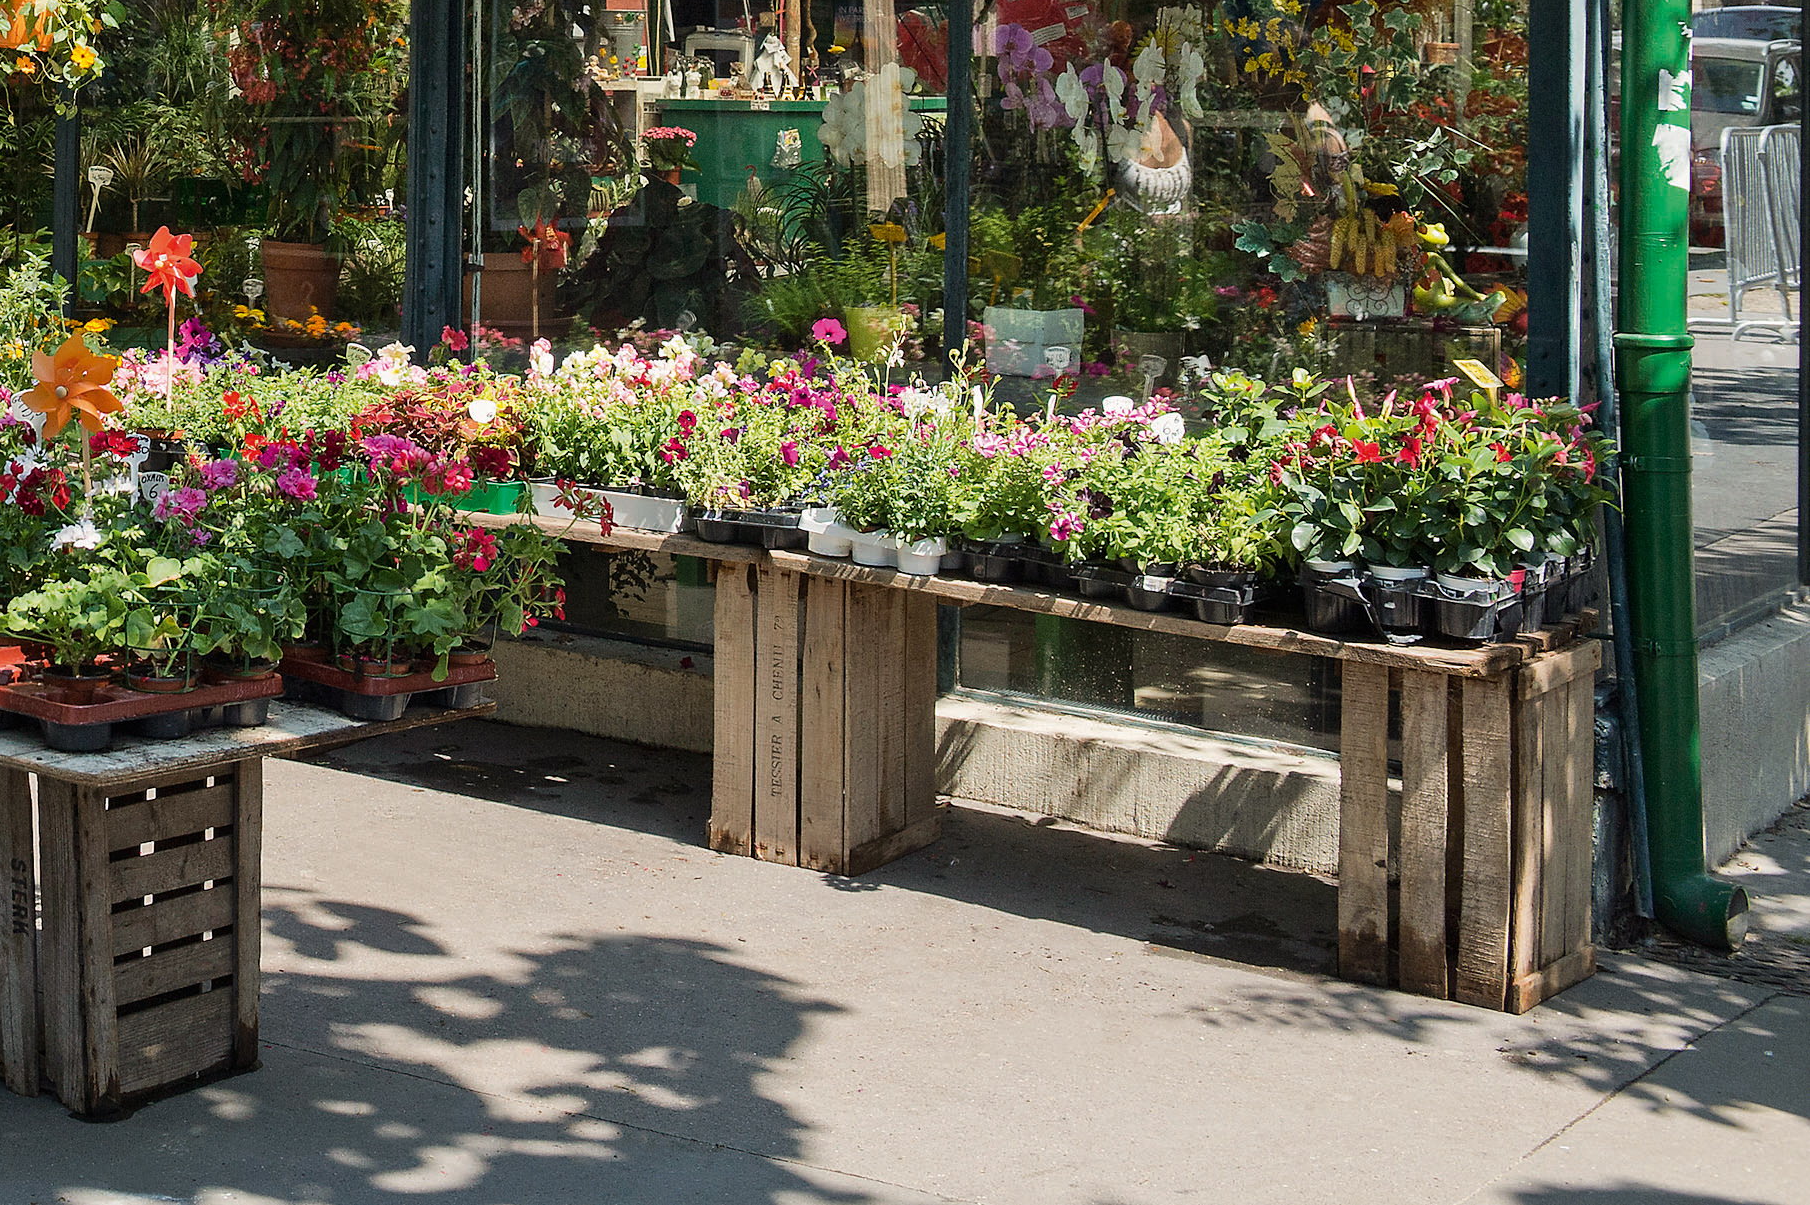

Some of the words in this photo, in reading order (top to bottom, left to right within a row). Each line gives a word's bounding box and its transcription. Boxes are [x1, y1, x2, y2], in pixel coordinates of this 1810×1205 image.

[149, 484, 158, 499] 6
[771, 715, 783, 725] A
[770, 734, 783, 797] TESSIER
[11, 857, 30, 938] STERK
